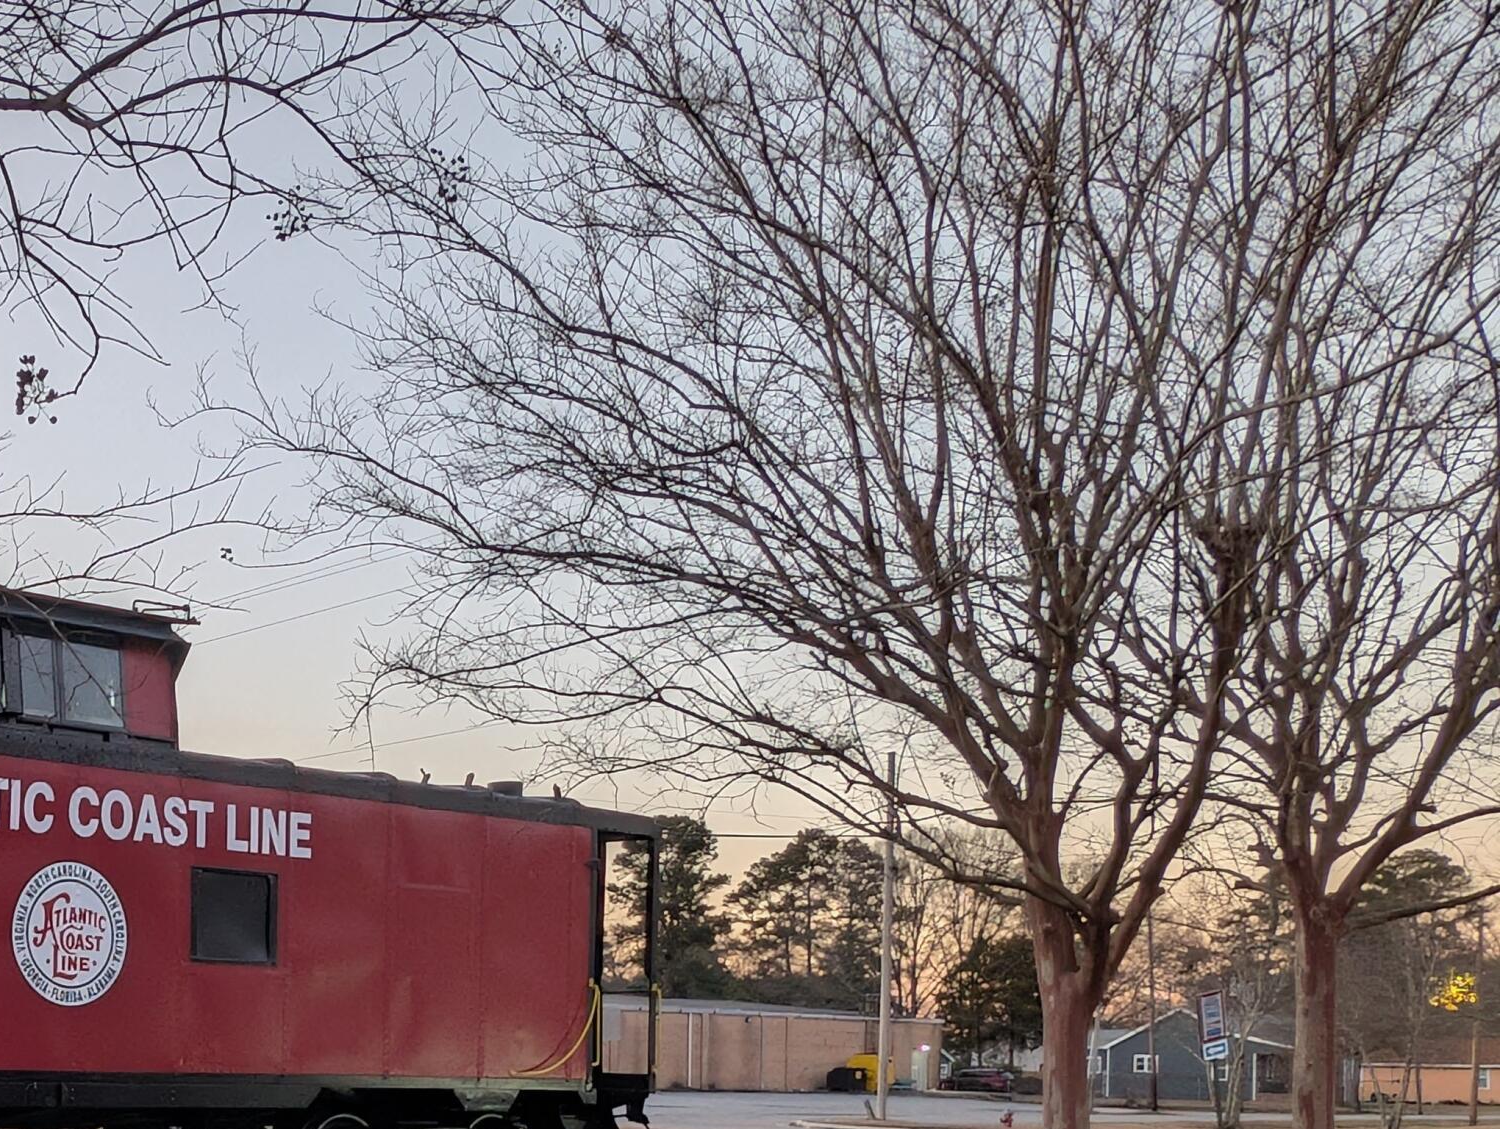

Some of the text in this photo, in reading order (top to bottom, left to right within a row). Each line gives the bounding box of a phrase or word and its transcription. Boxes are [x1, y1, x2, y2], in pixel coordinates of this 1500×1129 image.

[68, 786, 214, 848] COAST
[226, 804, 312, 859] LINE
[14, 864, 125, 963] VIRGINIA NORTH CAROLINA SOUTH CAROLINA
[33, 892, 107, 948] ATLANTIC
[52, 944, 90, 981] LINE
[60, 924, 103, 955] COAST
[21, 958, 116, 1003] GEORGIA FLORIDA ALABAMA
